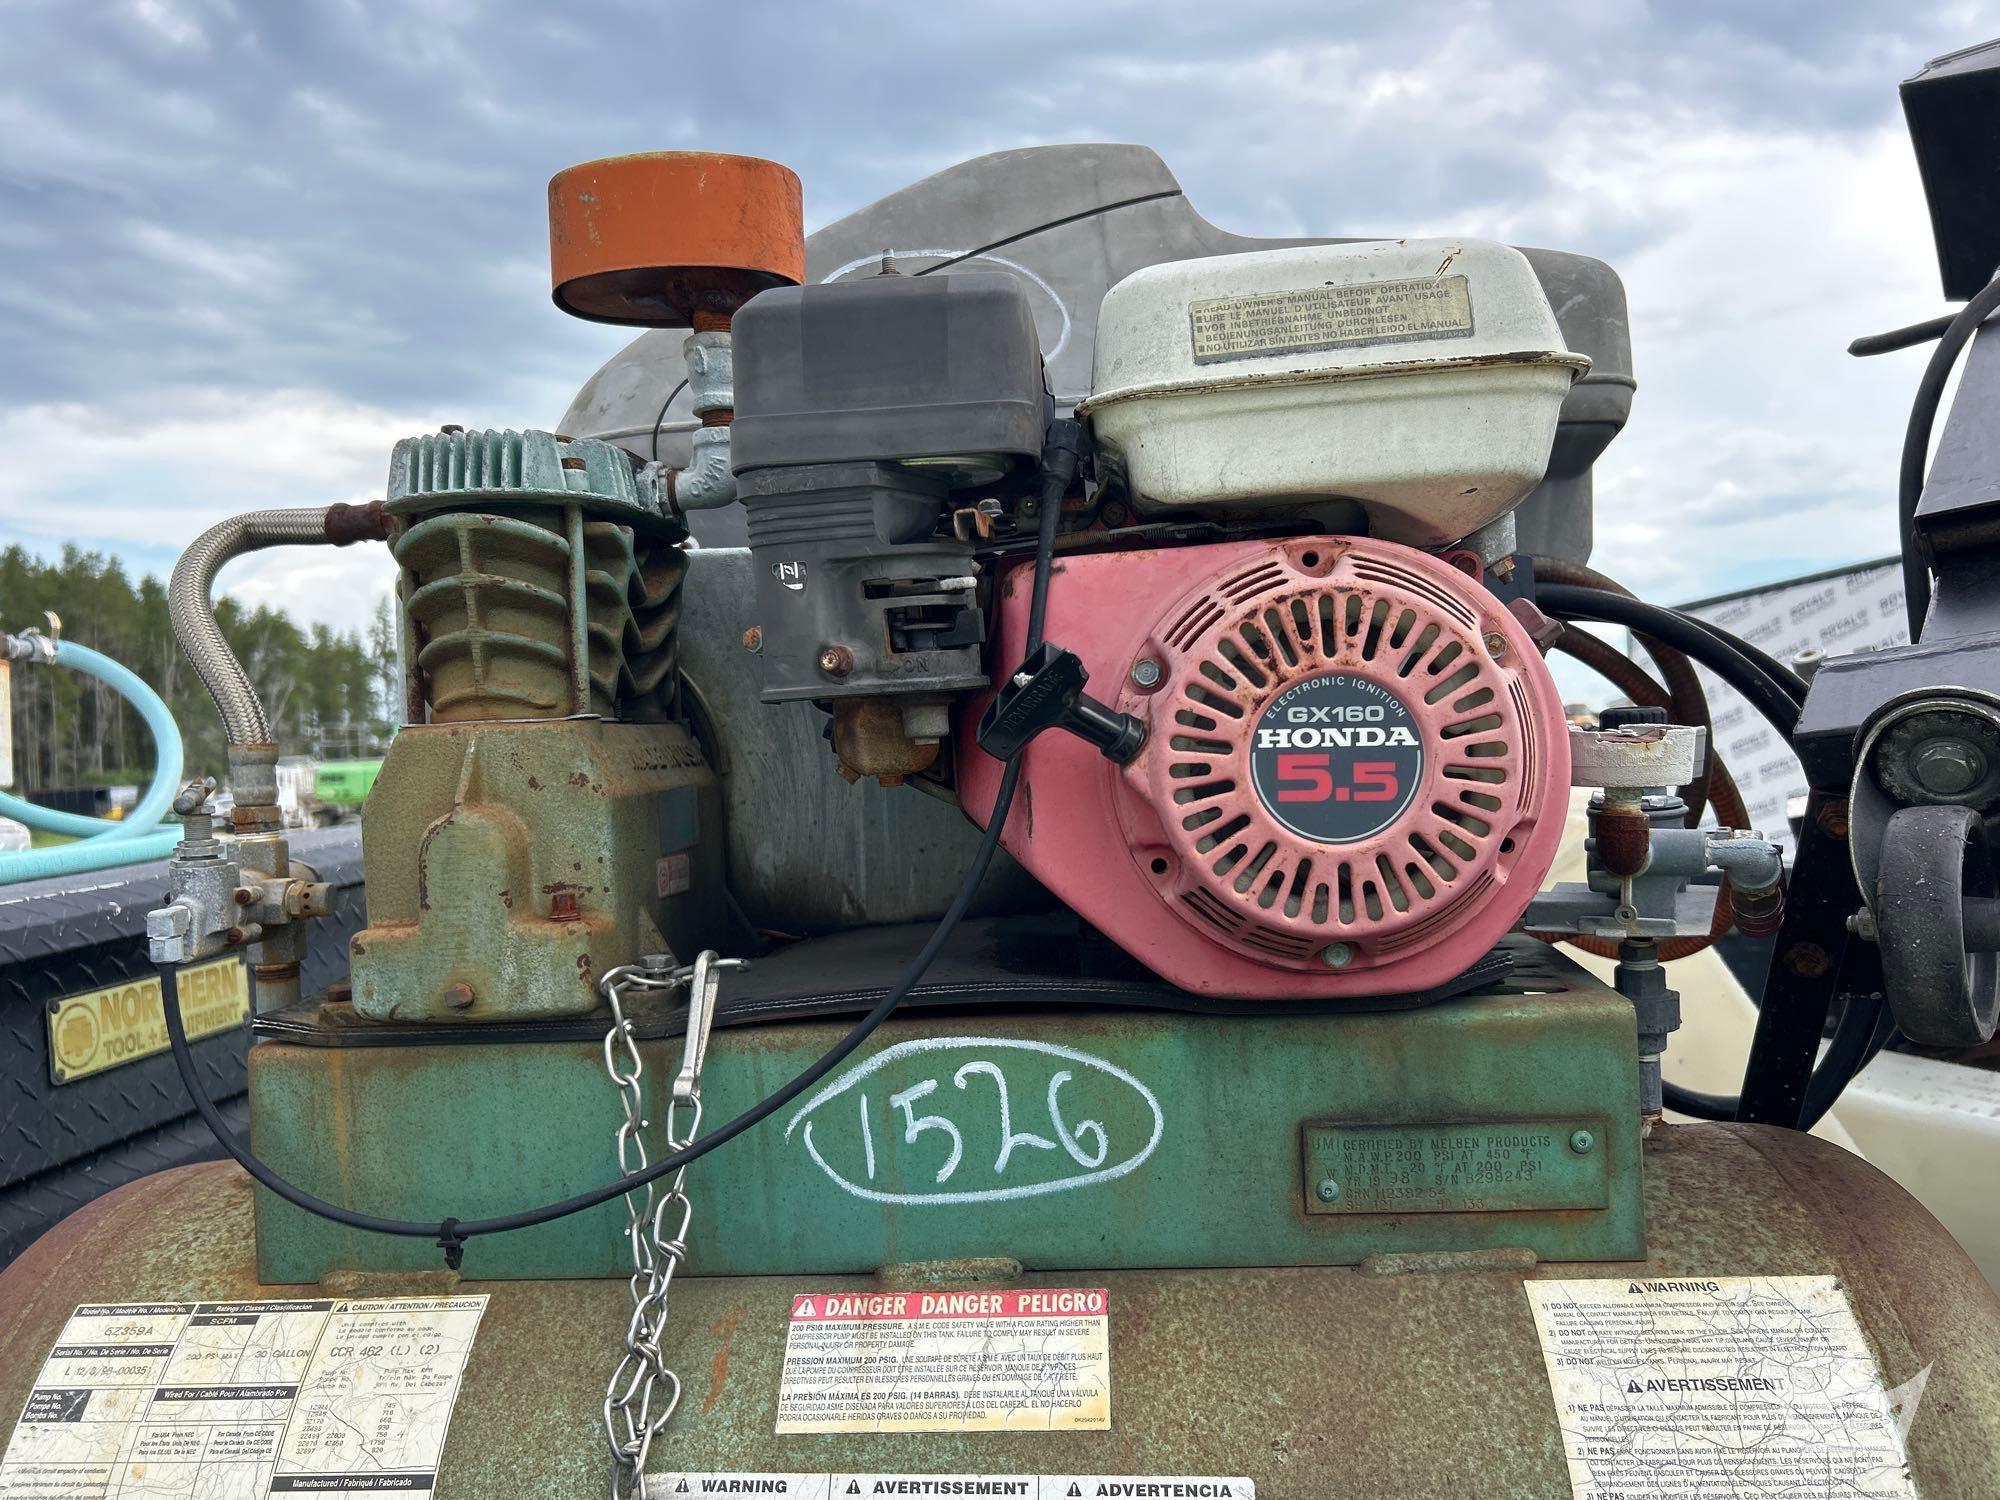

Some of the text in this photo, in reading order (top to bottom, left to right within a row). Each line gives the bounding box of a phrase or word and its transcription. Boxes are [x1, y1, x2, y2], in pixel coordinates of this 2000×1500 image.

[1288, 293, 1332, 303] MANUAL
[1336, 288, 1376, 298] BEFORE
[1204, 314, 1225, 322] LIRE
[1246, 306, 1289, 317] MANUEL
[1294, 298, 1370, 312] D'UTILISATEUR
[1376, 294, 1409, 304] AVANT
[1204, 323, 1225, 332] VOR
[1231, 313, 1322, 329] INBETRIEBNAHME
[1206, 322, 1332, 342] BEDIENUNGSANLEITUNG
[1206, 344, 1220, 352] NO
[1223, 339, 1266, 350] UTILIZAR
[1288, 332, 1320, 343] ANTES
[1322, 331, 1337, 340] NO
[1340, 326, 1373, 336] HABER
[1376, 324, 1405, 333] LEIDO
[1421, 319, 1466, 329] MANUAL
[903, 658, 929, 672] ON
[1266, 677, 1405, 719] ELECTRONIC IGNITION
[1288, 706, 1384, 722] GX160
[1258, 727, 1419, 748] HONDA
[1277, 754, 1398, 802] 5.5
[104, 1034, 145, 1059] TOOL
[860, 1060, 1108, 1183] 1526
[1344, 1140, 1402, 1151] CERTIFIED
[1410, 1140, 1423, 1149] BY
[1488, 1136, 1551, 1147] PRODUCTS
[1397, 1151, 1421, 1161] 200
[1434, 1151, 1454, 1160] PSI
[1462, 1150, 1473, 1159] AT
[1486, 1150, 1510, 1159] 450
[1455, 1162, 1467, 1172] AT
[1477, 1162, 1501, 1171] 200
[1521, 1161, 1541, 1171] PSI
[1435, 1175, 1458, 1185] S/N
[1642, 1281, 1719, 1293] WARNING
[352, 1303, 385, 1311] CAUTION
[390, 1302, 429, 1310] ATTENTION
[825, 1292, 1103, 1317] DANGER DANGER PELIGRO
[791, 1332, 832, 1340] COMPRESSOR
[880, 1331, 911, 1339] INSTALLED
[330, 1344, 440, 1357] CCR 462 (L) (2)
[789, 1342, 820, 1350] PERSONAL
[273, 1350, 312, 1358] GALLON
[787, 1357, 824, 1365] PRESSION
[826, 1357, 862, 1365] MAXIMUM
[879, 1356, 898, 1364] PSIG.
[1646, 1378, 1785, 1392] AVERTISSEMENT
[33, 1394, 50, 1402] Pump
[829, 1392, 858, 1400] MÁXIMA
[861, 1392, 871, 1400] ES
[910, 1391, 922, 1400] (14
[293, 1478, 412, 1488] Manufactured Fabriqué Fabricado
[702, 1480, 787, 1493] WARNING
[873, 1481, 1028, 1495] AVERTISSEMENT
[1096, 1484, 1232, 1497] ADVERTENCIA
